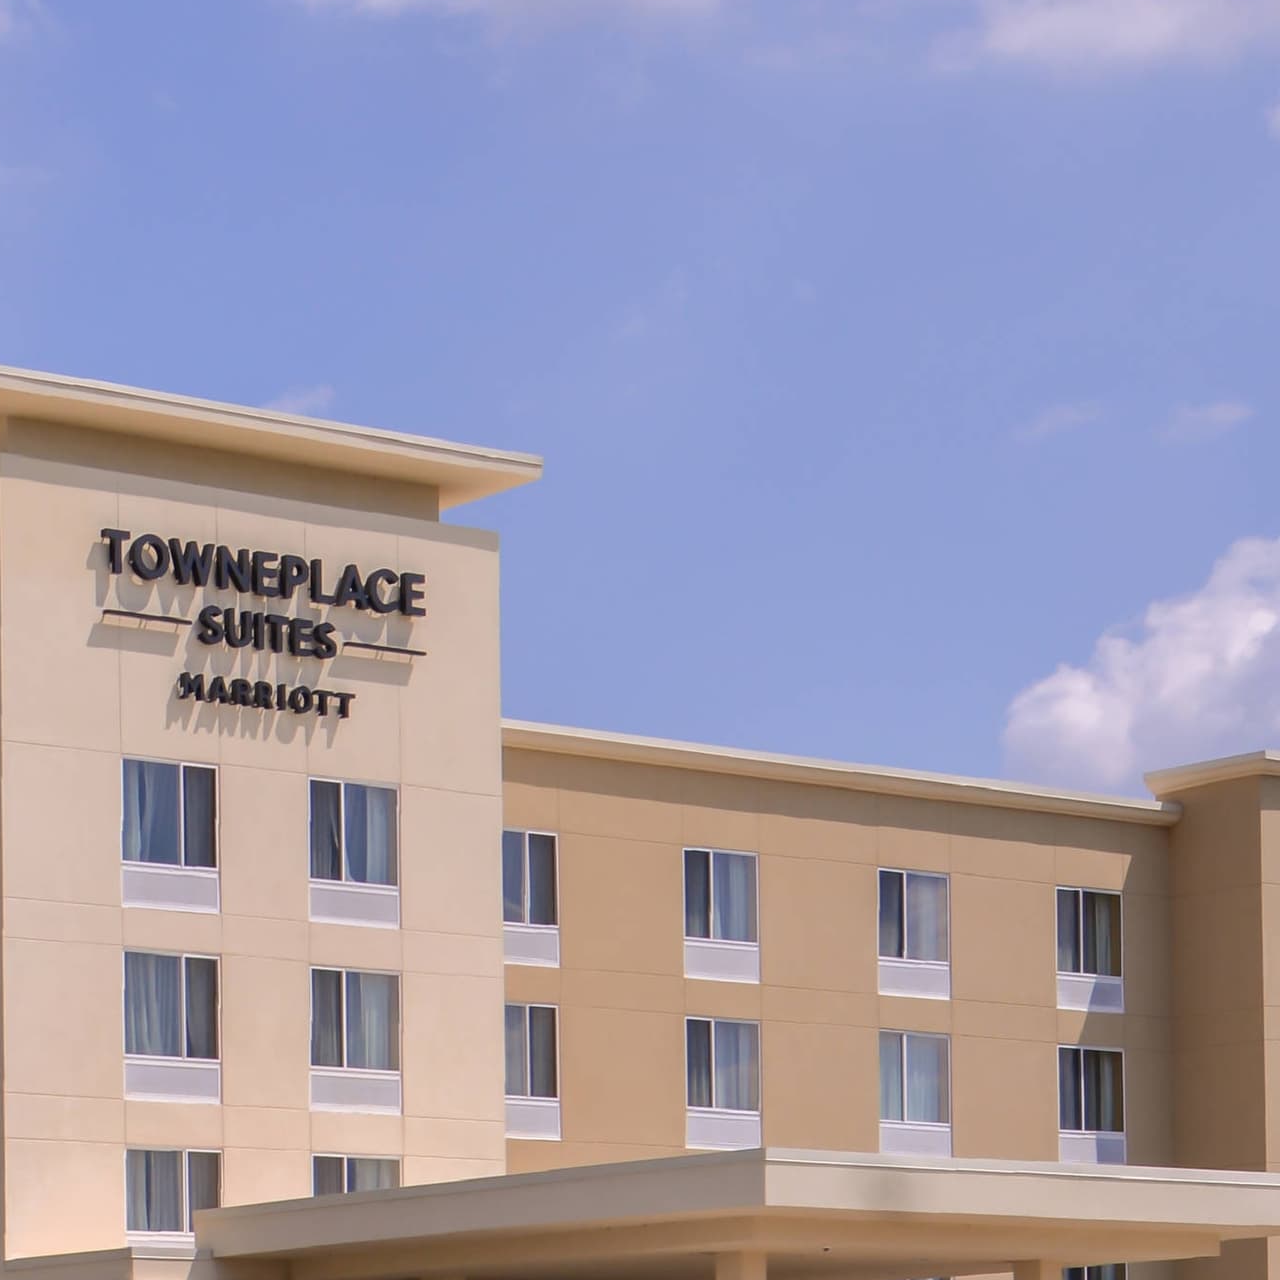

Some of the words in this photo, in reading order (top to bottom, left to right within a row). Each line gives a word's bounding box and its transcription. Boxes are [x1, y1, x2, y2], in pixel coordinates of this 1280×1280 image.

[101, 528, 427, 616] TOWNEPLACE
[197, 605, 337, 659] SUITES
[178, 671, 356, 719] MARRIOTT
